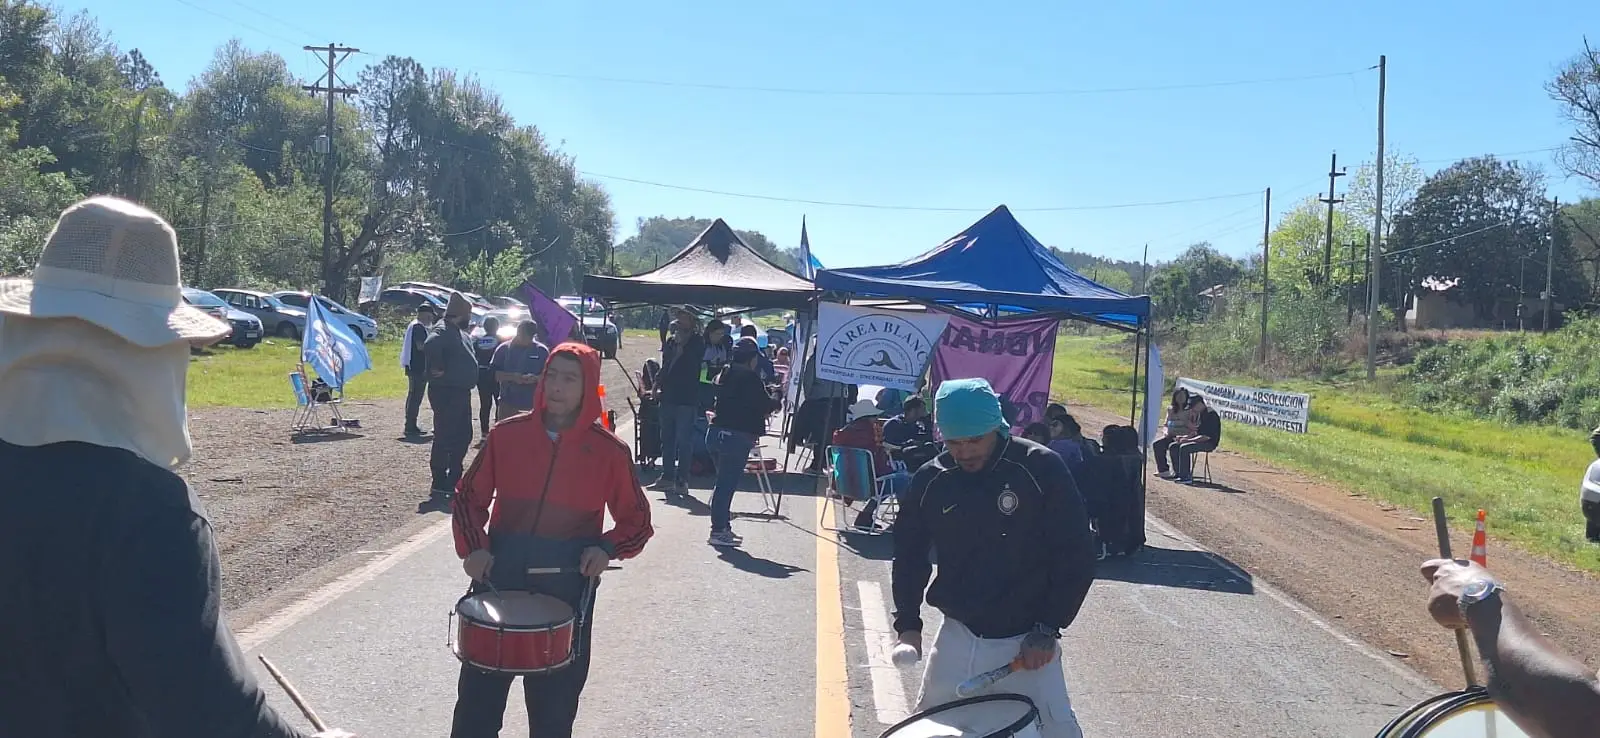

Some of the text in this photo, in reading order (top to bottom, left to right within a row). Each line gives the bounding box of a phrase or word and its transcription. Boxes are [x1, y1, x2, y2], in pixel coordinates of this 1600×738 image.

[830, 322, 877, 362] MAREA
[883, 321, 929, 364] BLANC
[1252, 391, 1305, 410] ABSOLUCION
